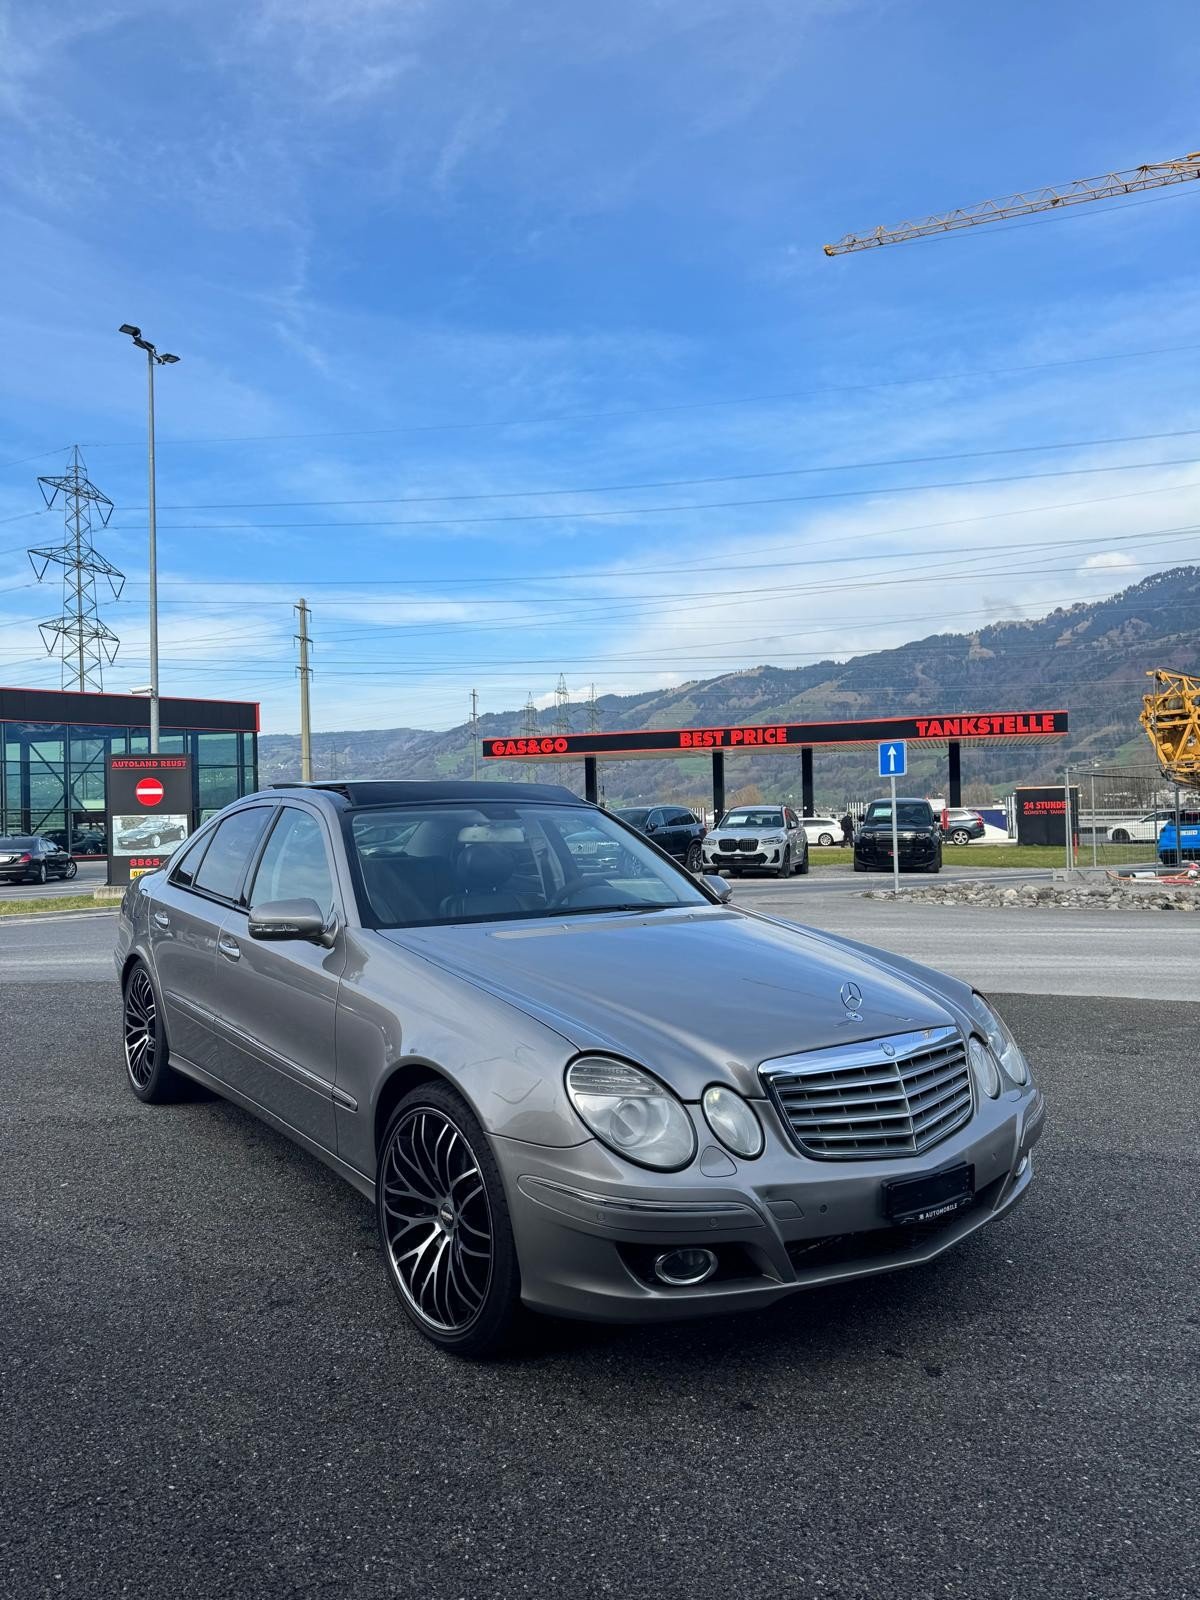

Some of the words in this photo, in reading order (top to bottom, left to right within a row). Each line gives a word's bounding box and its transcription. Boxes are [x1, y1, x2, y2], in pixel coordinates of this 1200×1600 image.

[916, 714, 1054, 736] TANKSTELLE
[680, 731, 724, 747] BEST
[730, 728, 787, 744] PRICE
[492, 738, 568, 755] GAS&GO
[111, 760, 158, 768] AUTOLAND
[1023, 801, 1034, 809] 24
[925, 1202, 958, 1218] AUTOMOBILE
